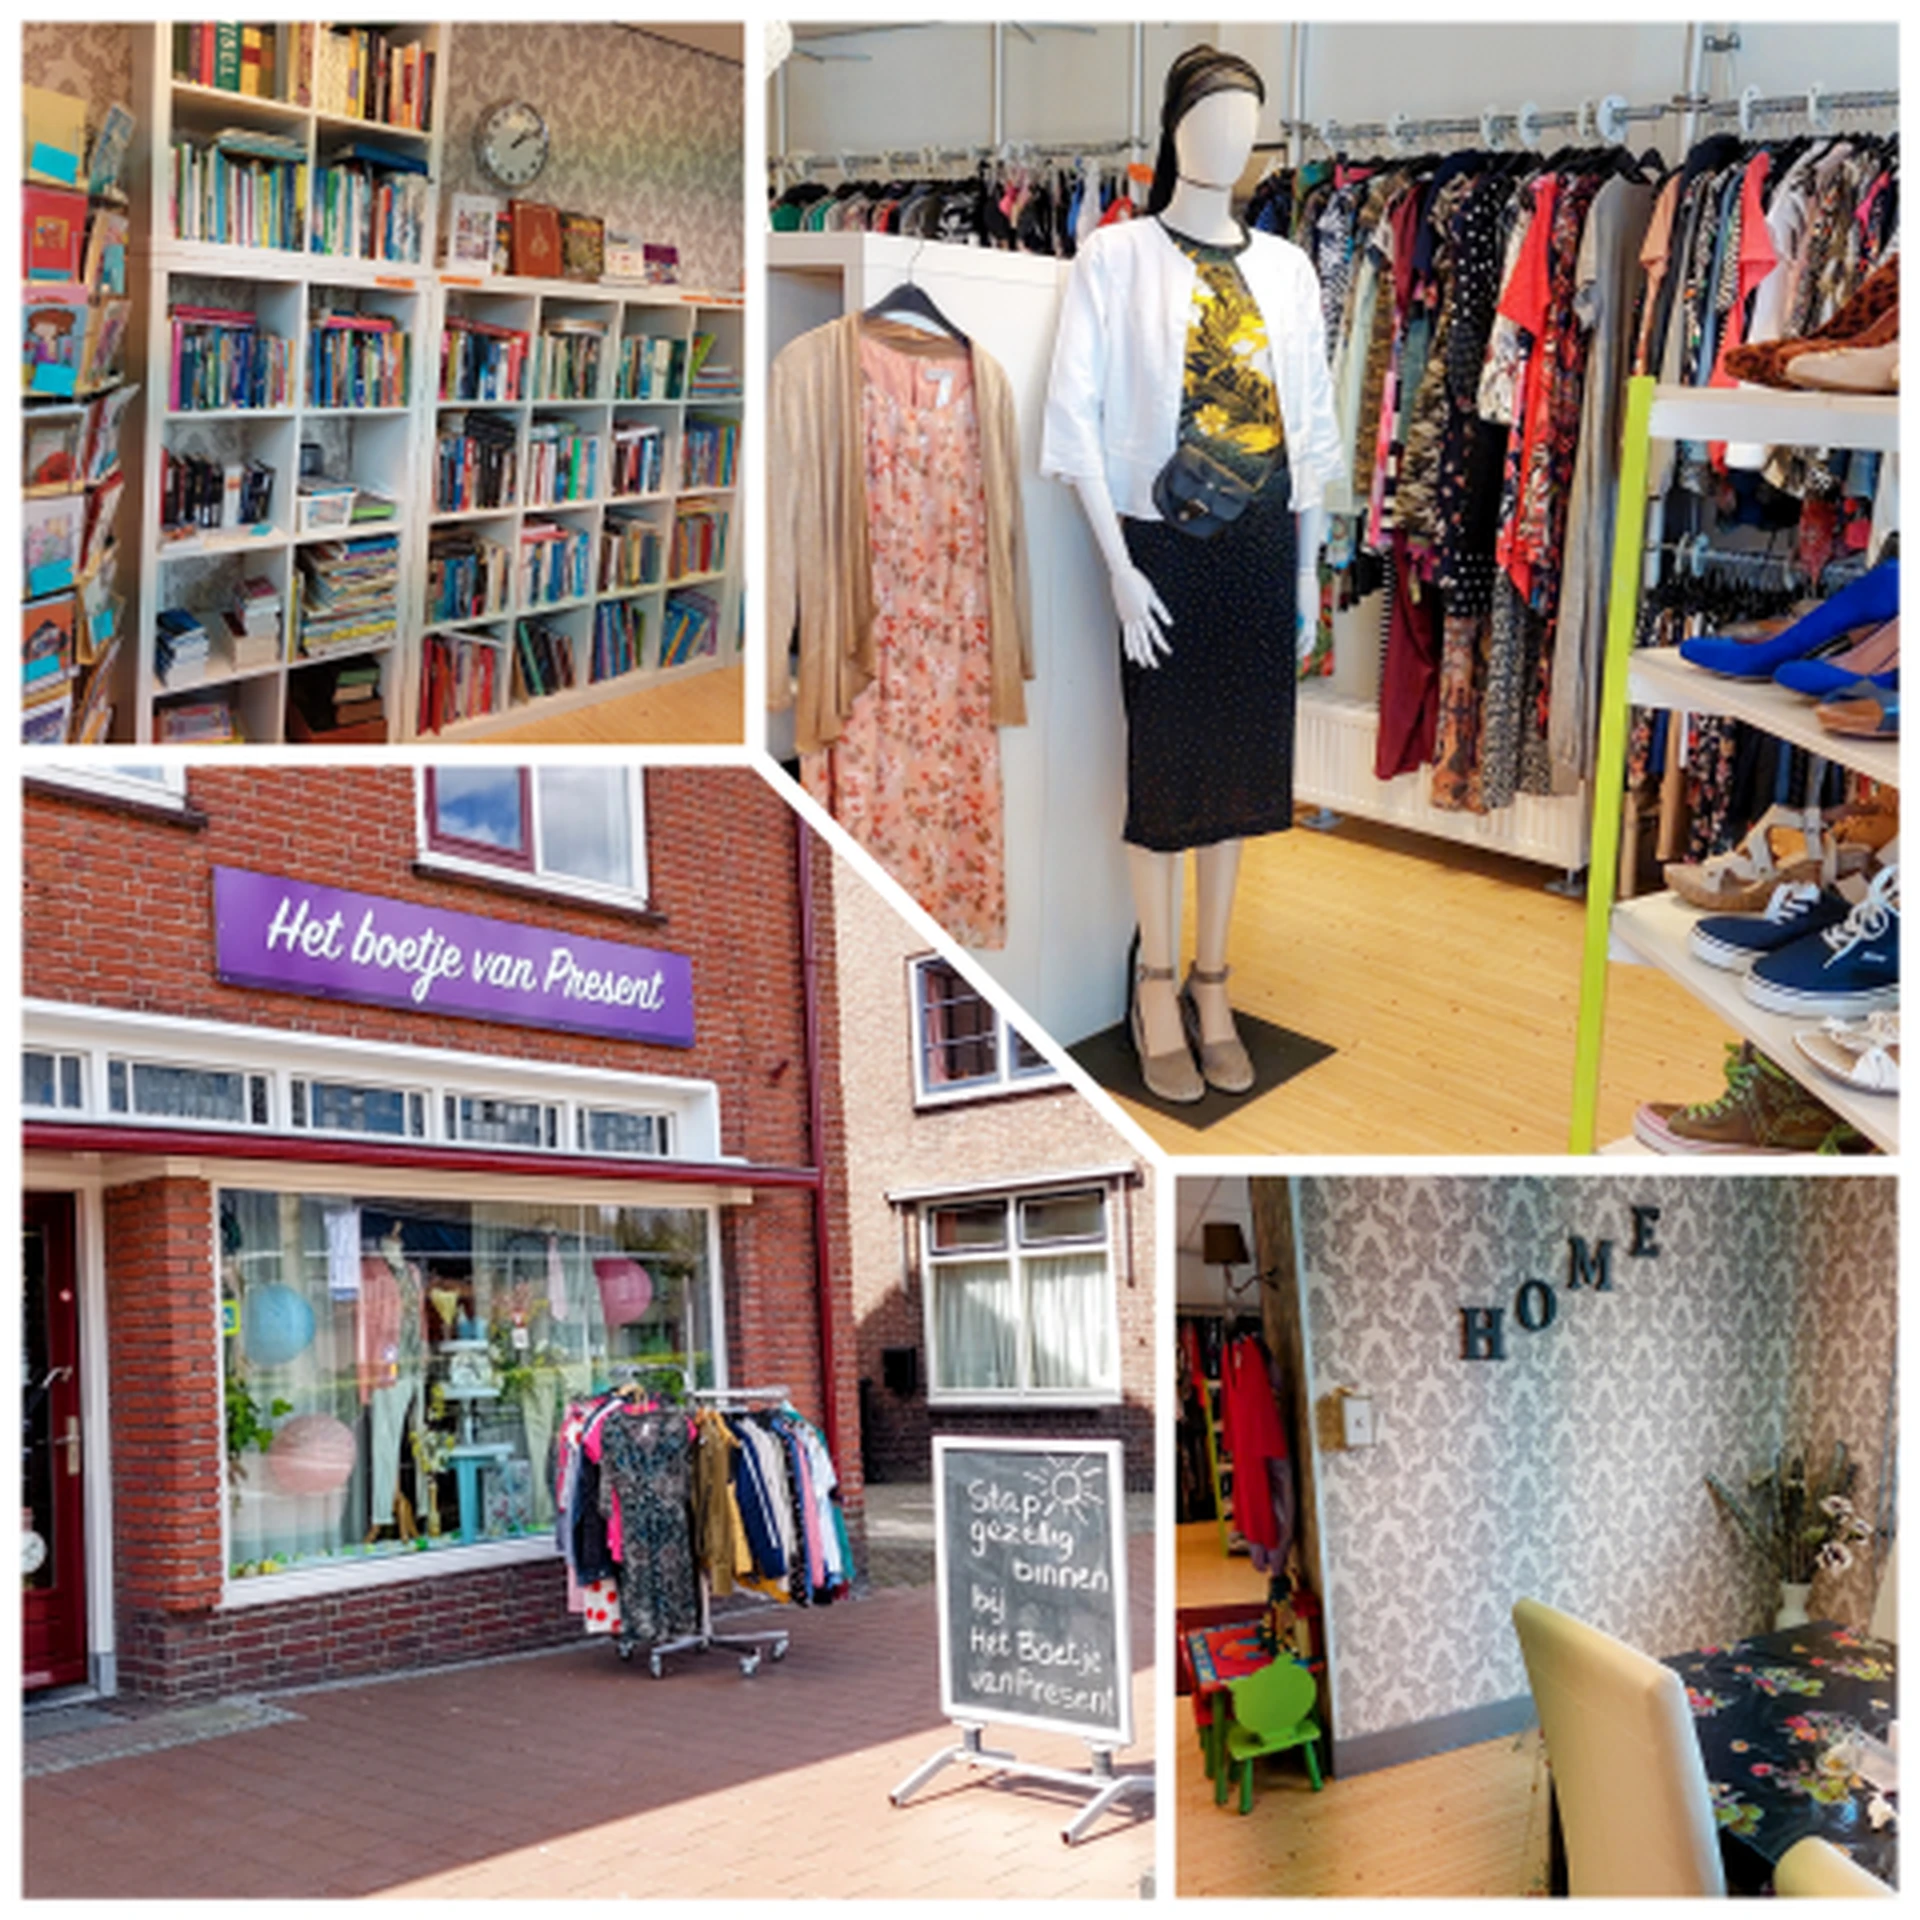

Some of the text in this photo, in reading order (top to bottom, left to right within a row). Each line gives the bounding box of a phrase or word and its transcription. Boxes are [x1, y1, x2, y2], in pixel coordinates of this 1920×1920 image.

[265, 896, 666, 1012] Het boetje van Present
[1457, 1205, 1662, 1361] HOME
[966, 1478, 1042, 1523] Stap
[1012, 1557, 1110, 1593] binnen
[970, 1582, 1006, 1626] bij
[970, 1625, 1102, 1678] Het Boetje
